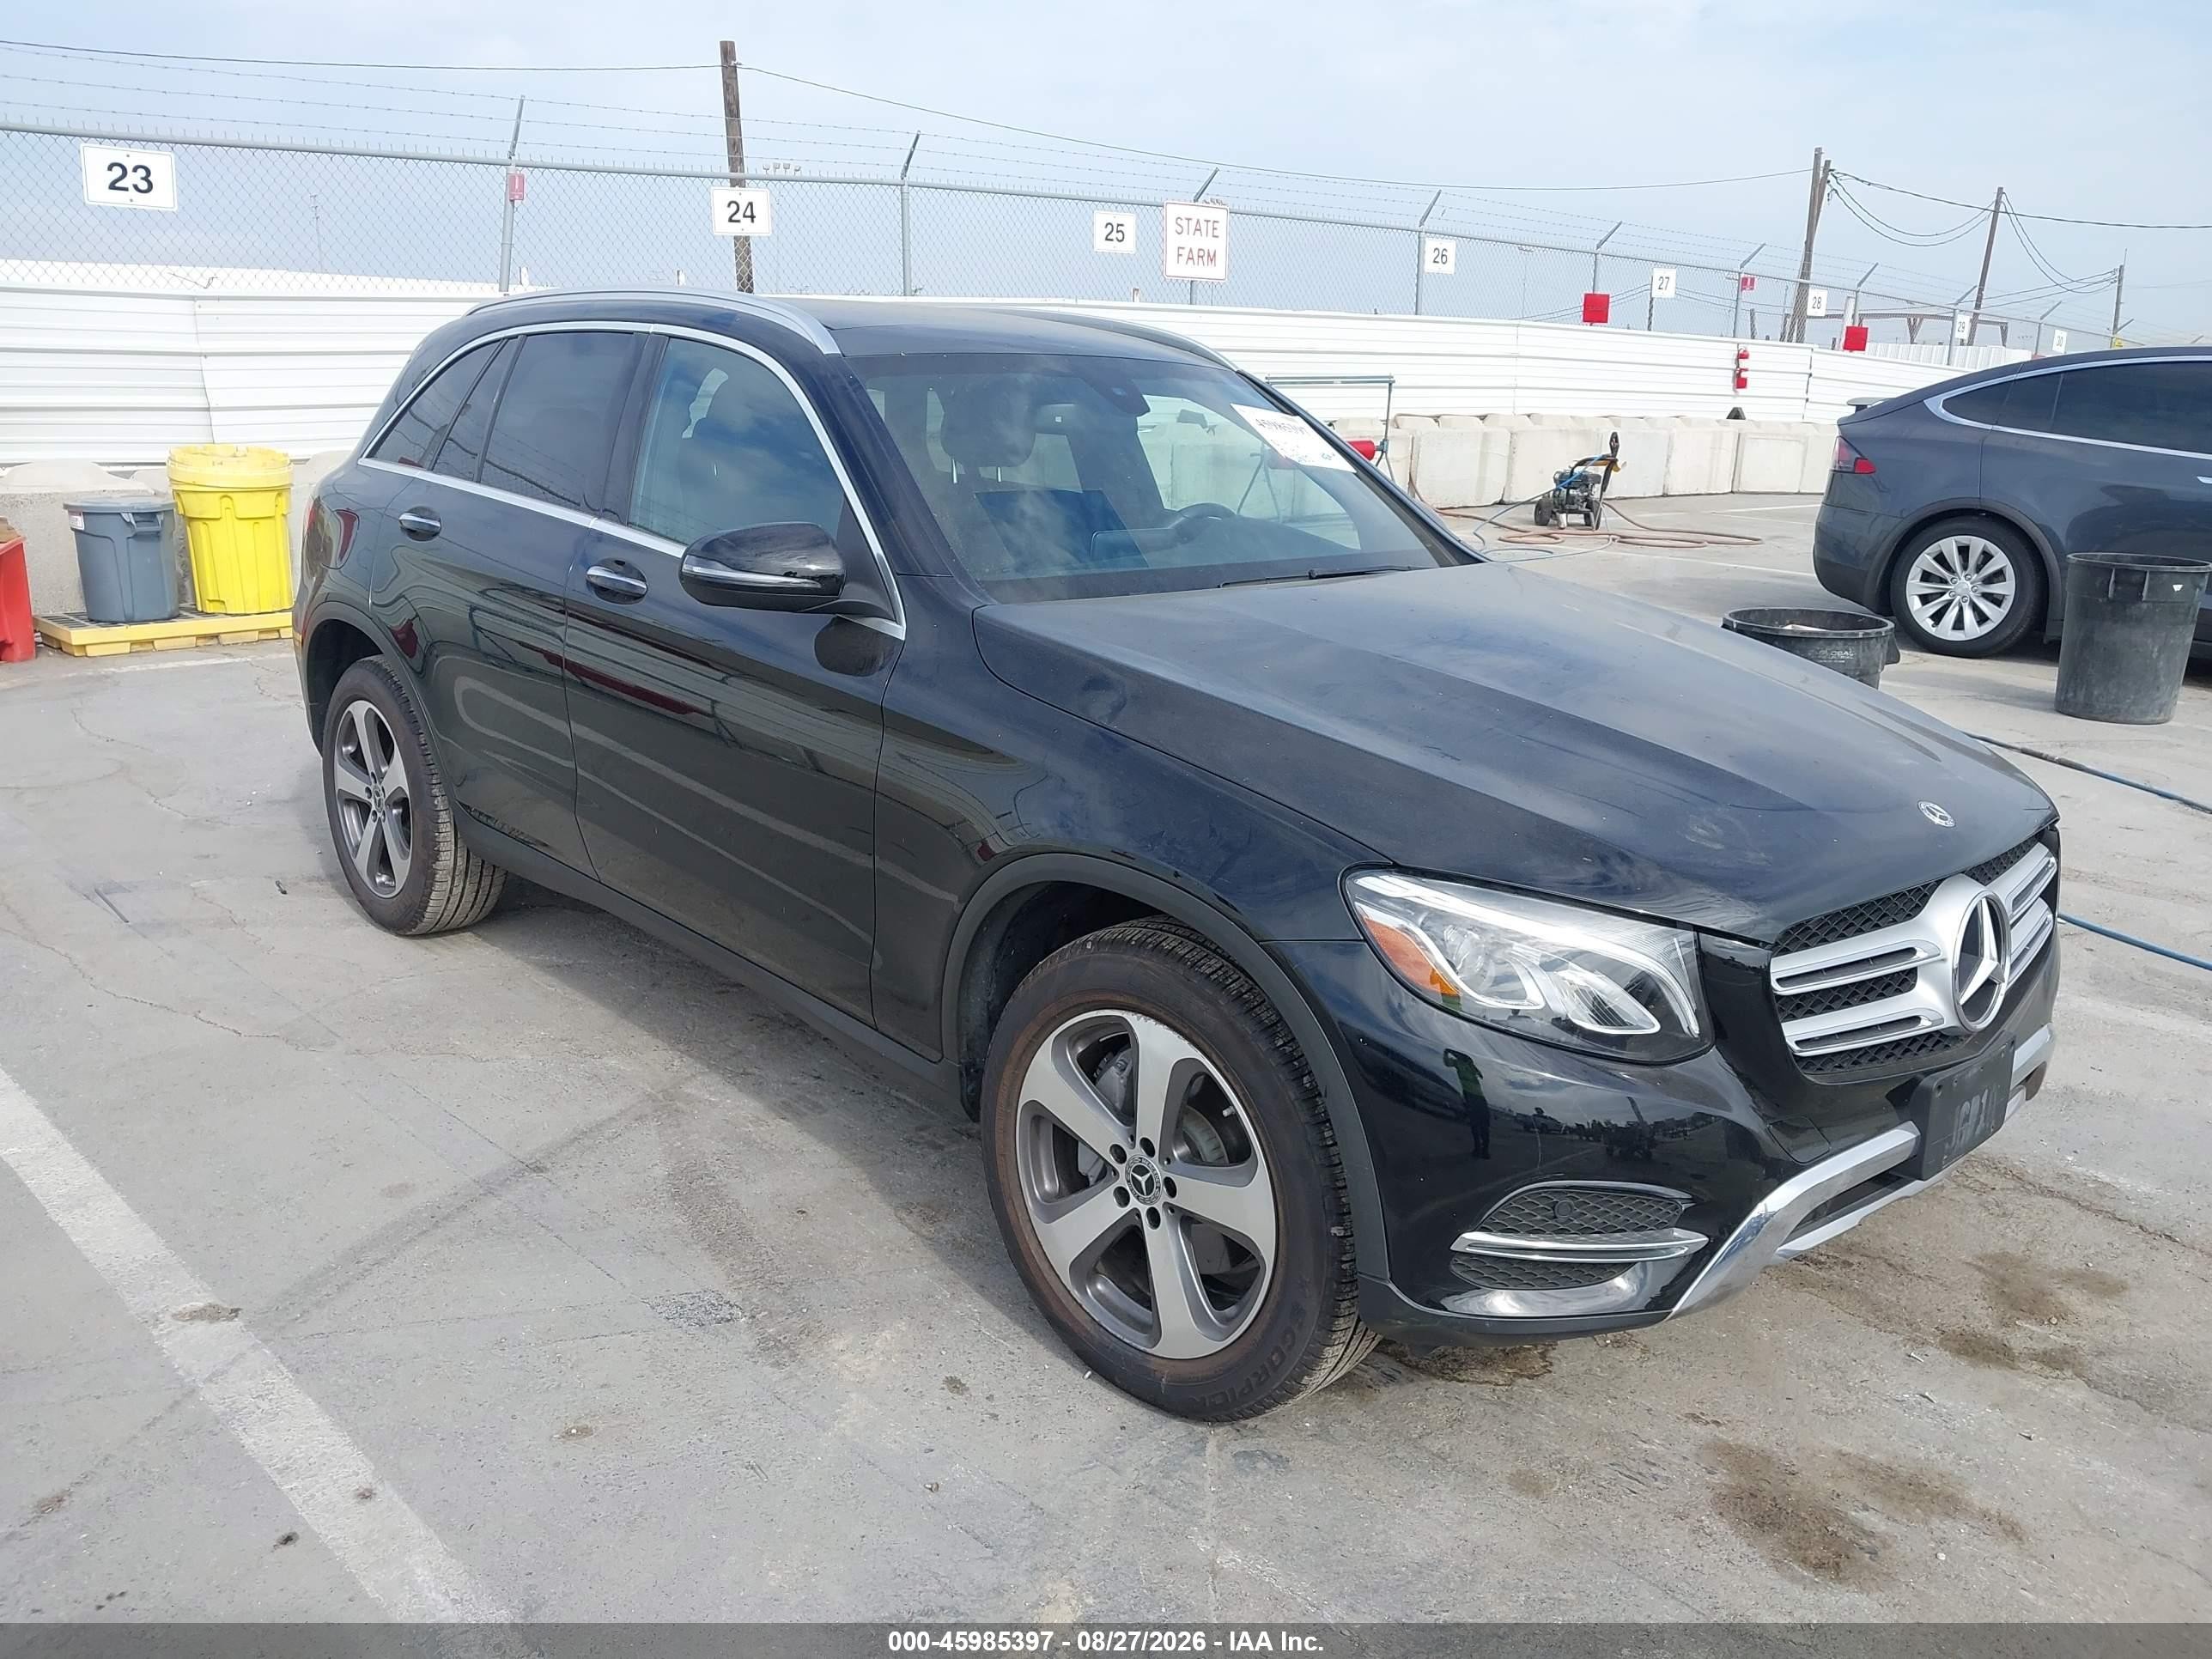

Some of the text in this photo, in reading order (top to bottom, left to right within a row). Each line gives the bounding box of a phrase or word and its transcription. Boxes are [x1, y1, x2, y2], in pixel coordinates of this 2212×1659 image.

[106, 161, 154, 194] 23
[726, 200, 756, 223] 24
[1104, 222, 1125, 242] 25
[1175, 216, 1220, 238] STATE
[1176, 246, 1217, 267] FARM
[1433, 247, 1448, 264] 26
[1657, 276, 1670, 290] 27
[1812, 296, 1822, 309] 28
[1958, 321, 1966, 333] 29
